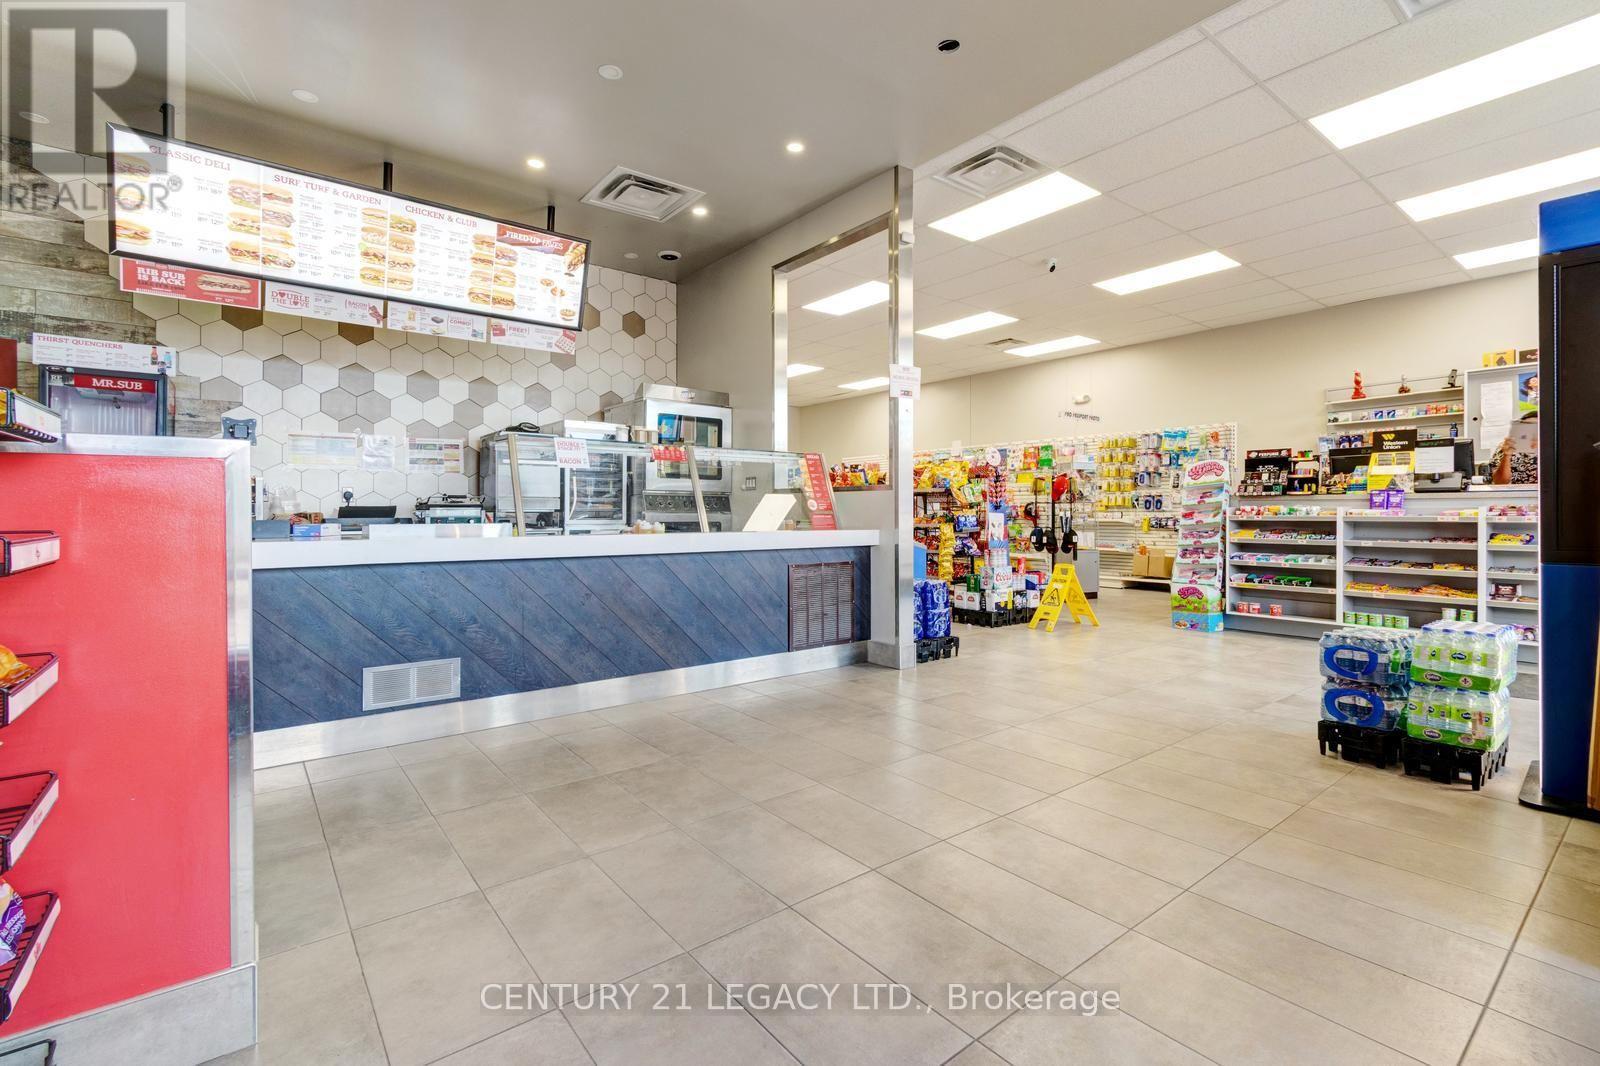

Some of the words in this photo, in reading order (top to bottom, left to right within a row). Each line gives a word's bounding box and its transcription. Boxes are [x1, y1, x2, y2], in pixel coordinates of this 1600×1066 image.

[149, 145, 201, 164] CLASSIC
[204, 158, 231, 171] DELI
[274, 174, 301, 187] SURF
[303, 181, 330, 193] TURF
[333, 187, 340, 197] &
[342, 190, 382, 206] GARDEN
[405, 205, 445, 221] CHICKEN
[447, 213, 454, 223] &
[455, 216, 478, 229] CLUB
[137, 267, 159, 276] RIB
[161, 270, 185, 280] SUB
[272, 297, 287, 305] THE
[36, 334, 70, 344] THIRST
[71, 339, 124, 350] QUENCHERS
[91, 378, 143, 390] MR.SUB
